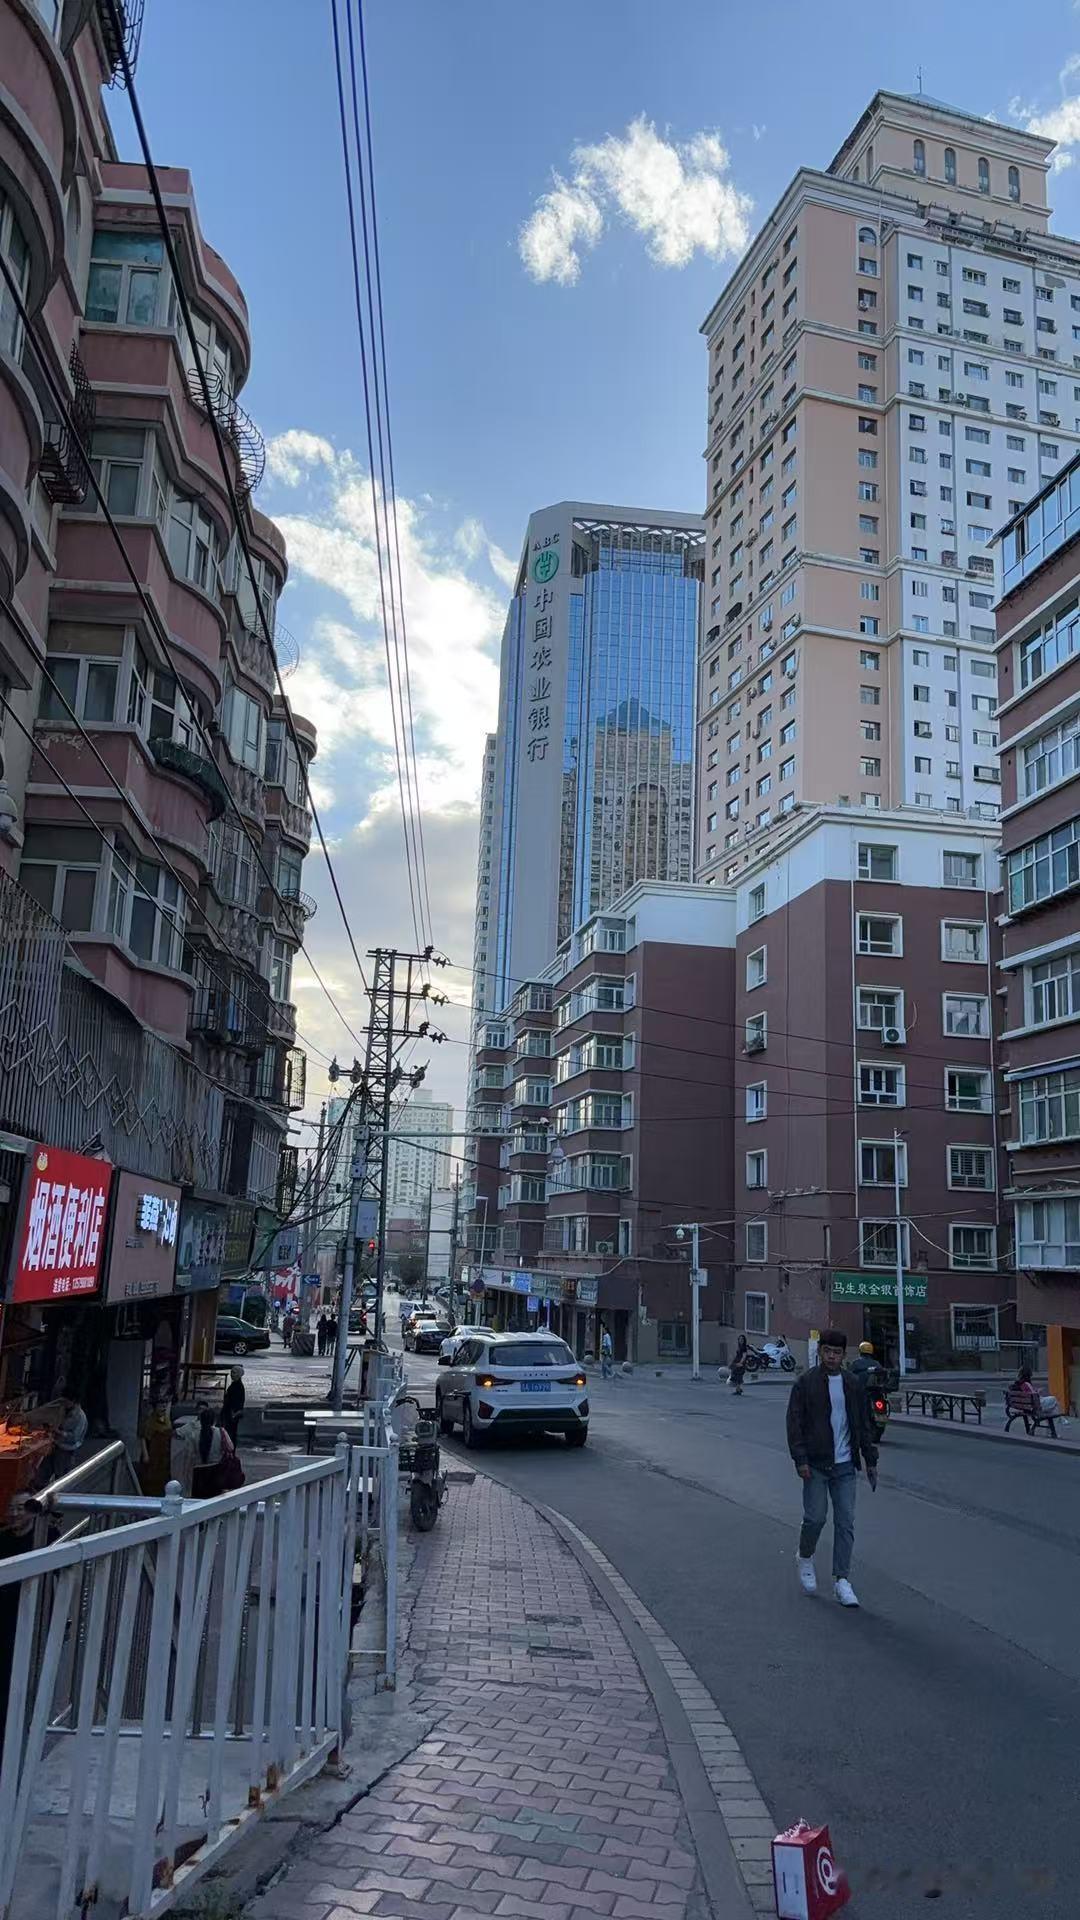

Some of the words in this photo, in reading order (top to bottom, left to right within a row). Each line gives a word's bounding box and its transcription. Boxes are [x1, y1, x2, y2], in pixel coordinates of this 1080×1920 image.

[532, 532, 560, 552] ABC
[527, 588, 554, 763] 中国农业银行
[22, 1178, 106, 1271] 烟酒便利店
